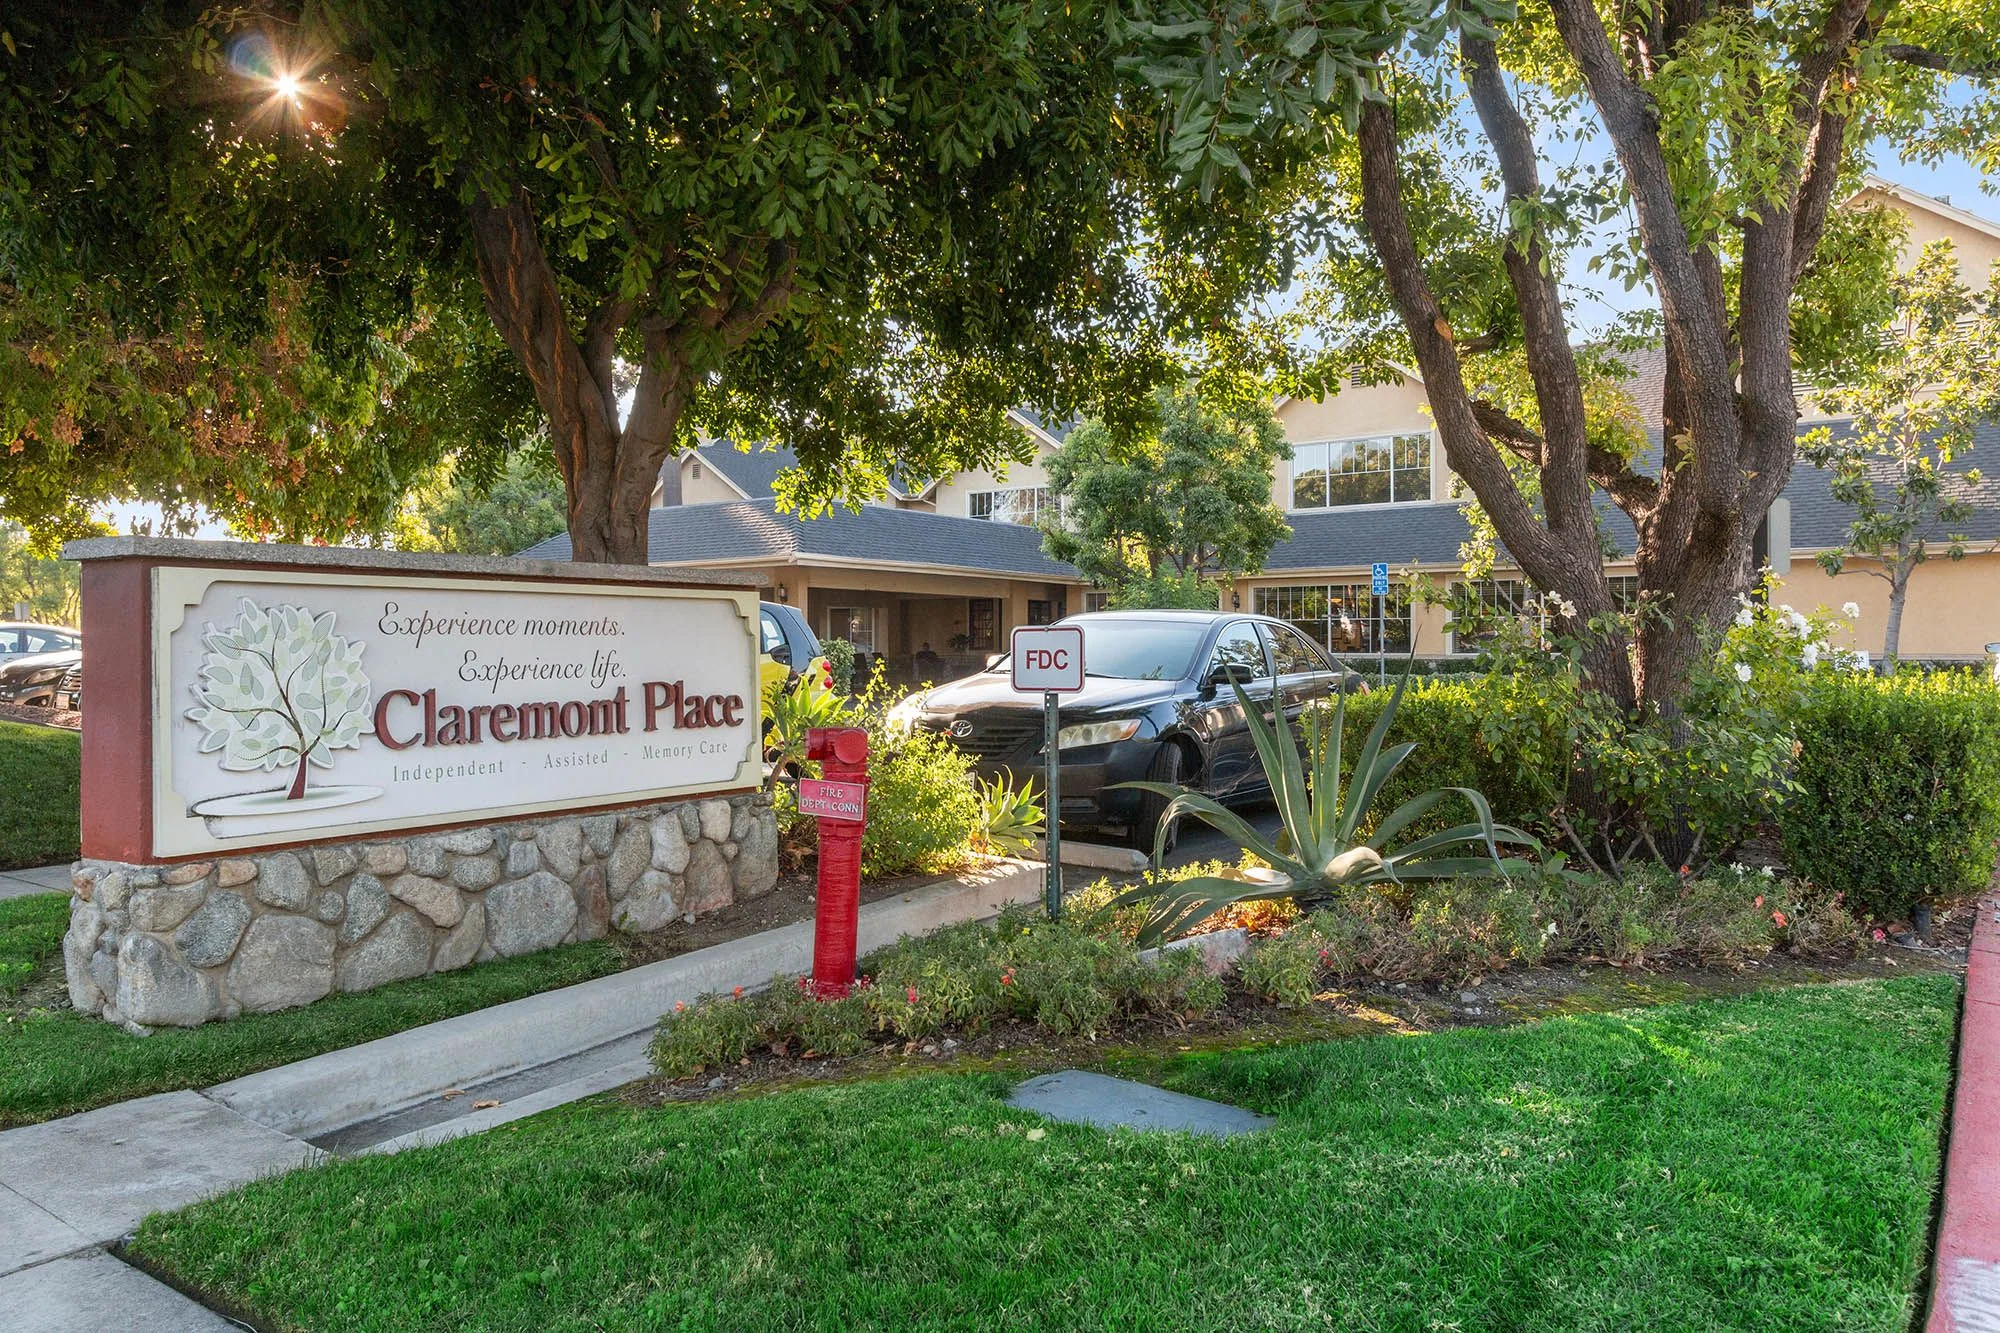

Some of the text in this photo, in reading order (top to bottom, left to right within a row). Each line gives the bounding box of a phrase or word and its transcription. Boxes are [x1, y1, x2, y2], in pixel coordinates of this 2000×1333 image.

[378, 601, 625, 648] Experience moments.
[458, 649, 626, 694] Experience life.
[1026, 649, 1068, 670] FDC
[374, 680, 744, 751] Claremont Place
[393, 759, 504, 783] Independent
[544, 749, 608, 769] Assisted
[642, 745, 693, 760] Memory
[700, 740, 728, 755] Care
[801, 799, 859, 813] DEPT CONN
[819, 786, 844, 798] FIRE
